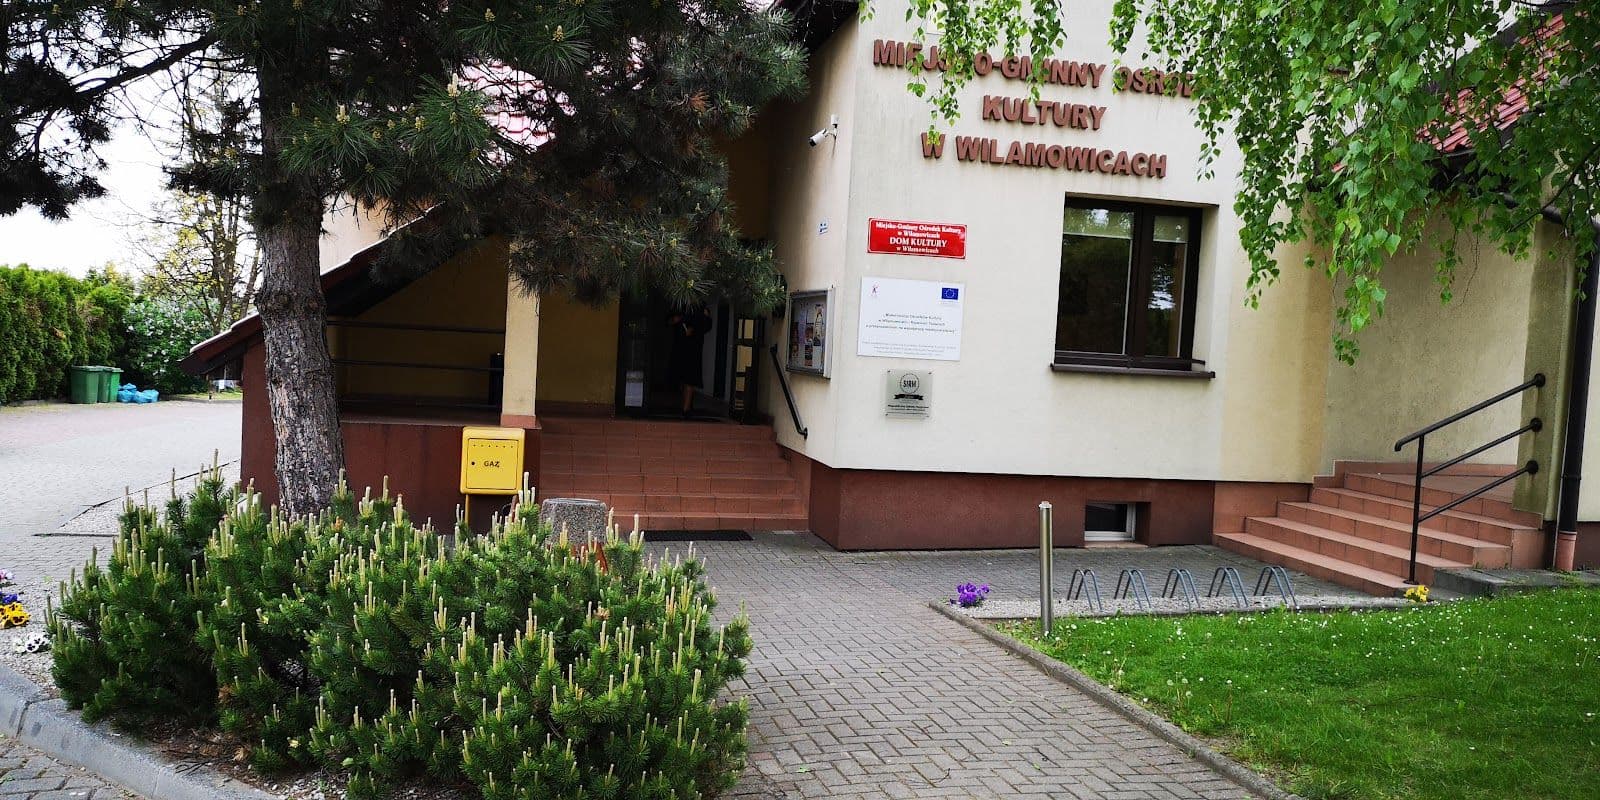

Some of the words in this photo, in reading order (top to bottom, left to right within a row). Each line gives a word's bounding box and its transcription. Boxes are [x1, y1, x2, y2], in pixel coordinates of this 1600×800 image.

[982, 94, 1107, 130] KULTURY
[921, 132, 946, 159] W
[955, 135, 1168, 179] WILAMOWICACH
[890, 237, 909, 246] DOM
[911, 237, 948, 248] KULTURY
[484, 460, 500, 468] GAZ
